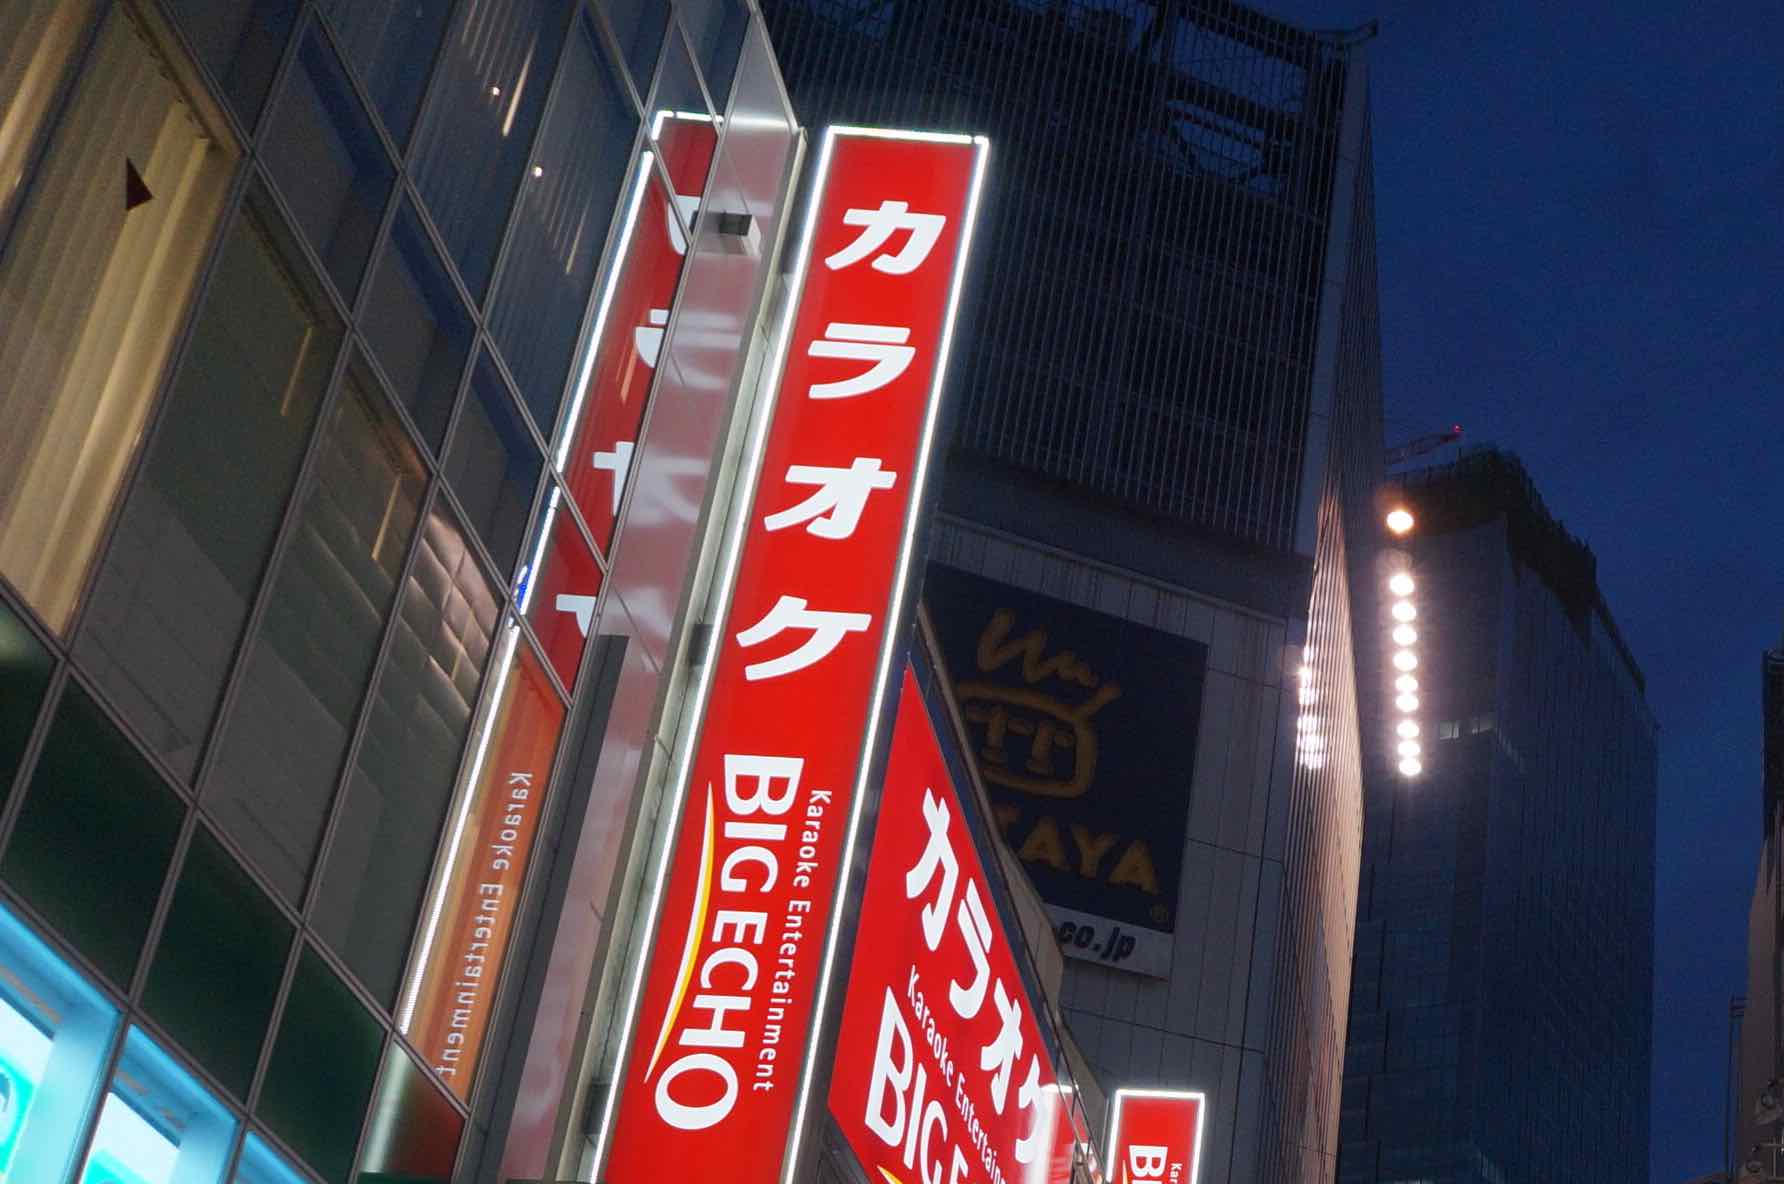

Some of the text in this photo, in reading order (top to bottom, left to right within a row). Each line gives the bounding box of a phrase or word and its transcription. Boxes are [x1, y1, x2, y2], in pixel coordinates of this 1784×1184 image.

[737, 200, 946, 681] カラオケ
[653, 753, 806, 1131] BIG ECHO
[752, 788, 833, 1093] Karaoke Entertainment
[904, 786, 1050, 1168] カラオケ
[906, 963, 956, 1088] Karaoke
